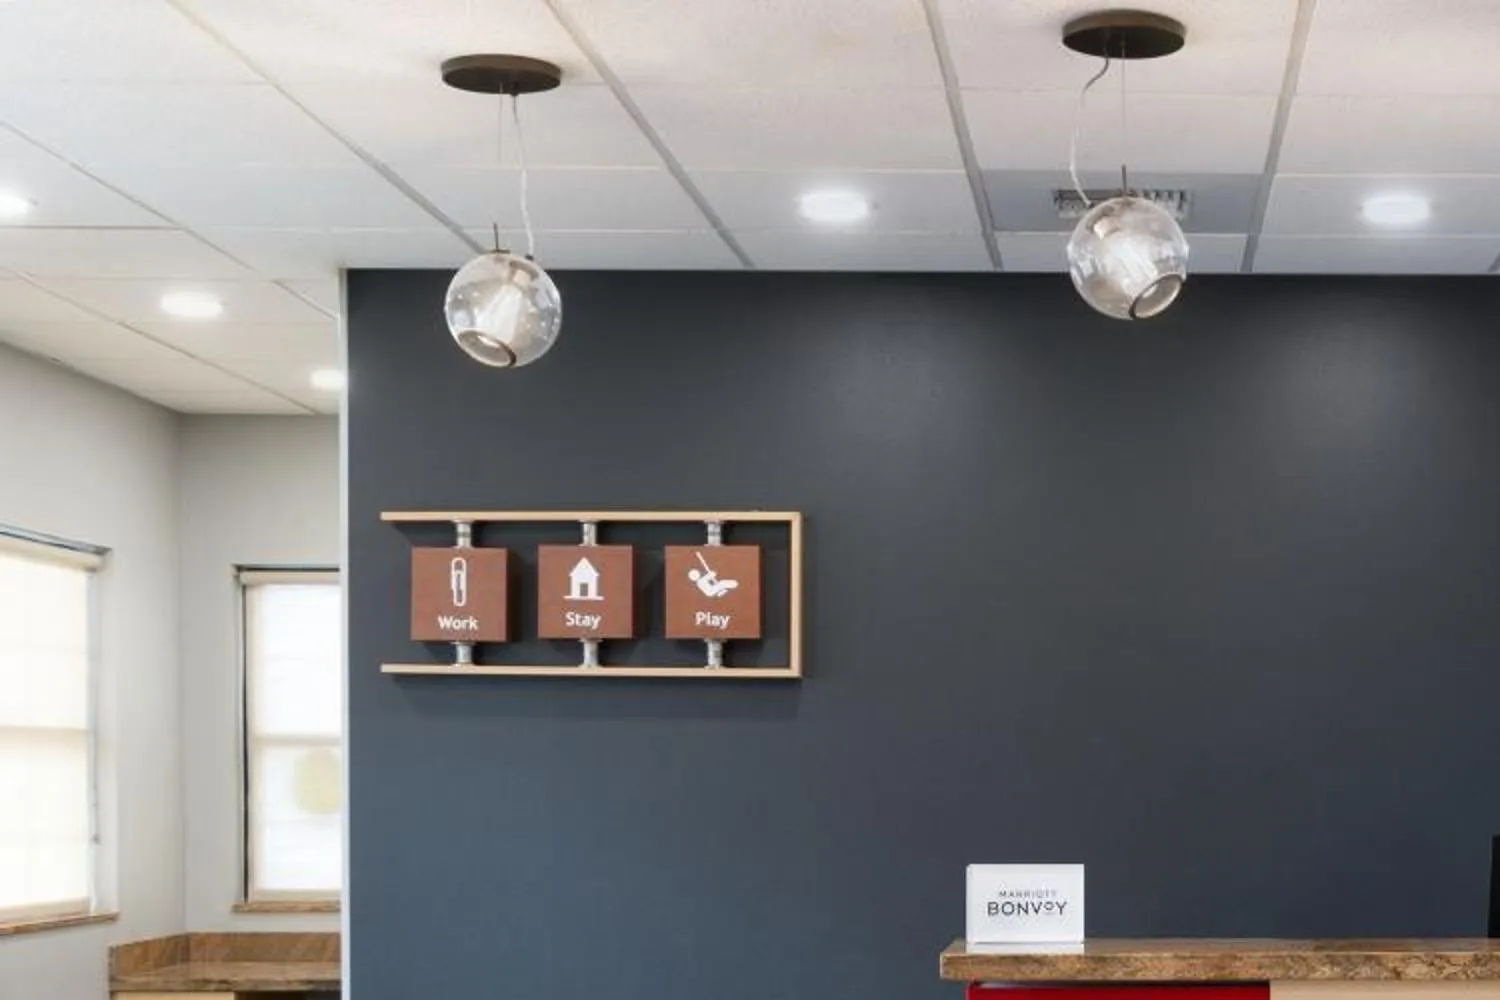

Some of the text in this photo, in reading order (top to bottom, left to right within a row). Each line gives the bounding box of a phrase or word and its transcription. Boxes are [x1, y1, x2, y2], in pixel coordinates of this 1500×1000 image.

[437, 614, 479, 631] Work
[565, 611, 602, 629] Stay
[695, 611, 730, 629] Play
[999, 889, 1057, 898] MARRIOTT
[987, 900, 1068, 917] BONVOY
